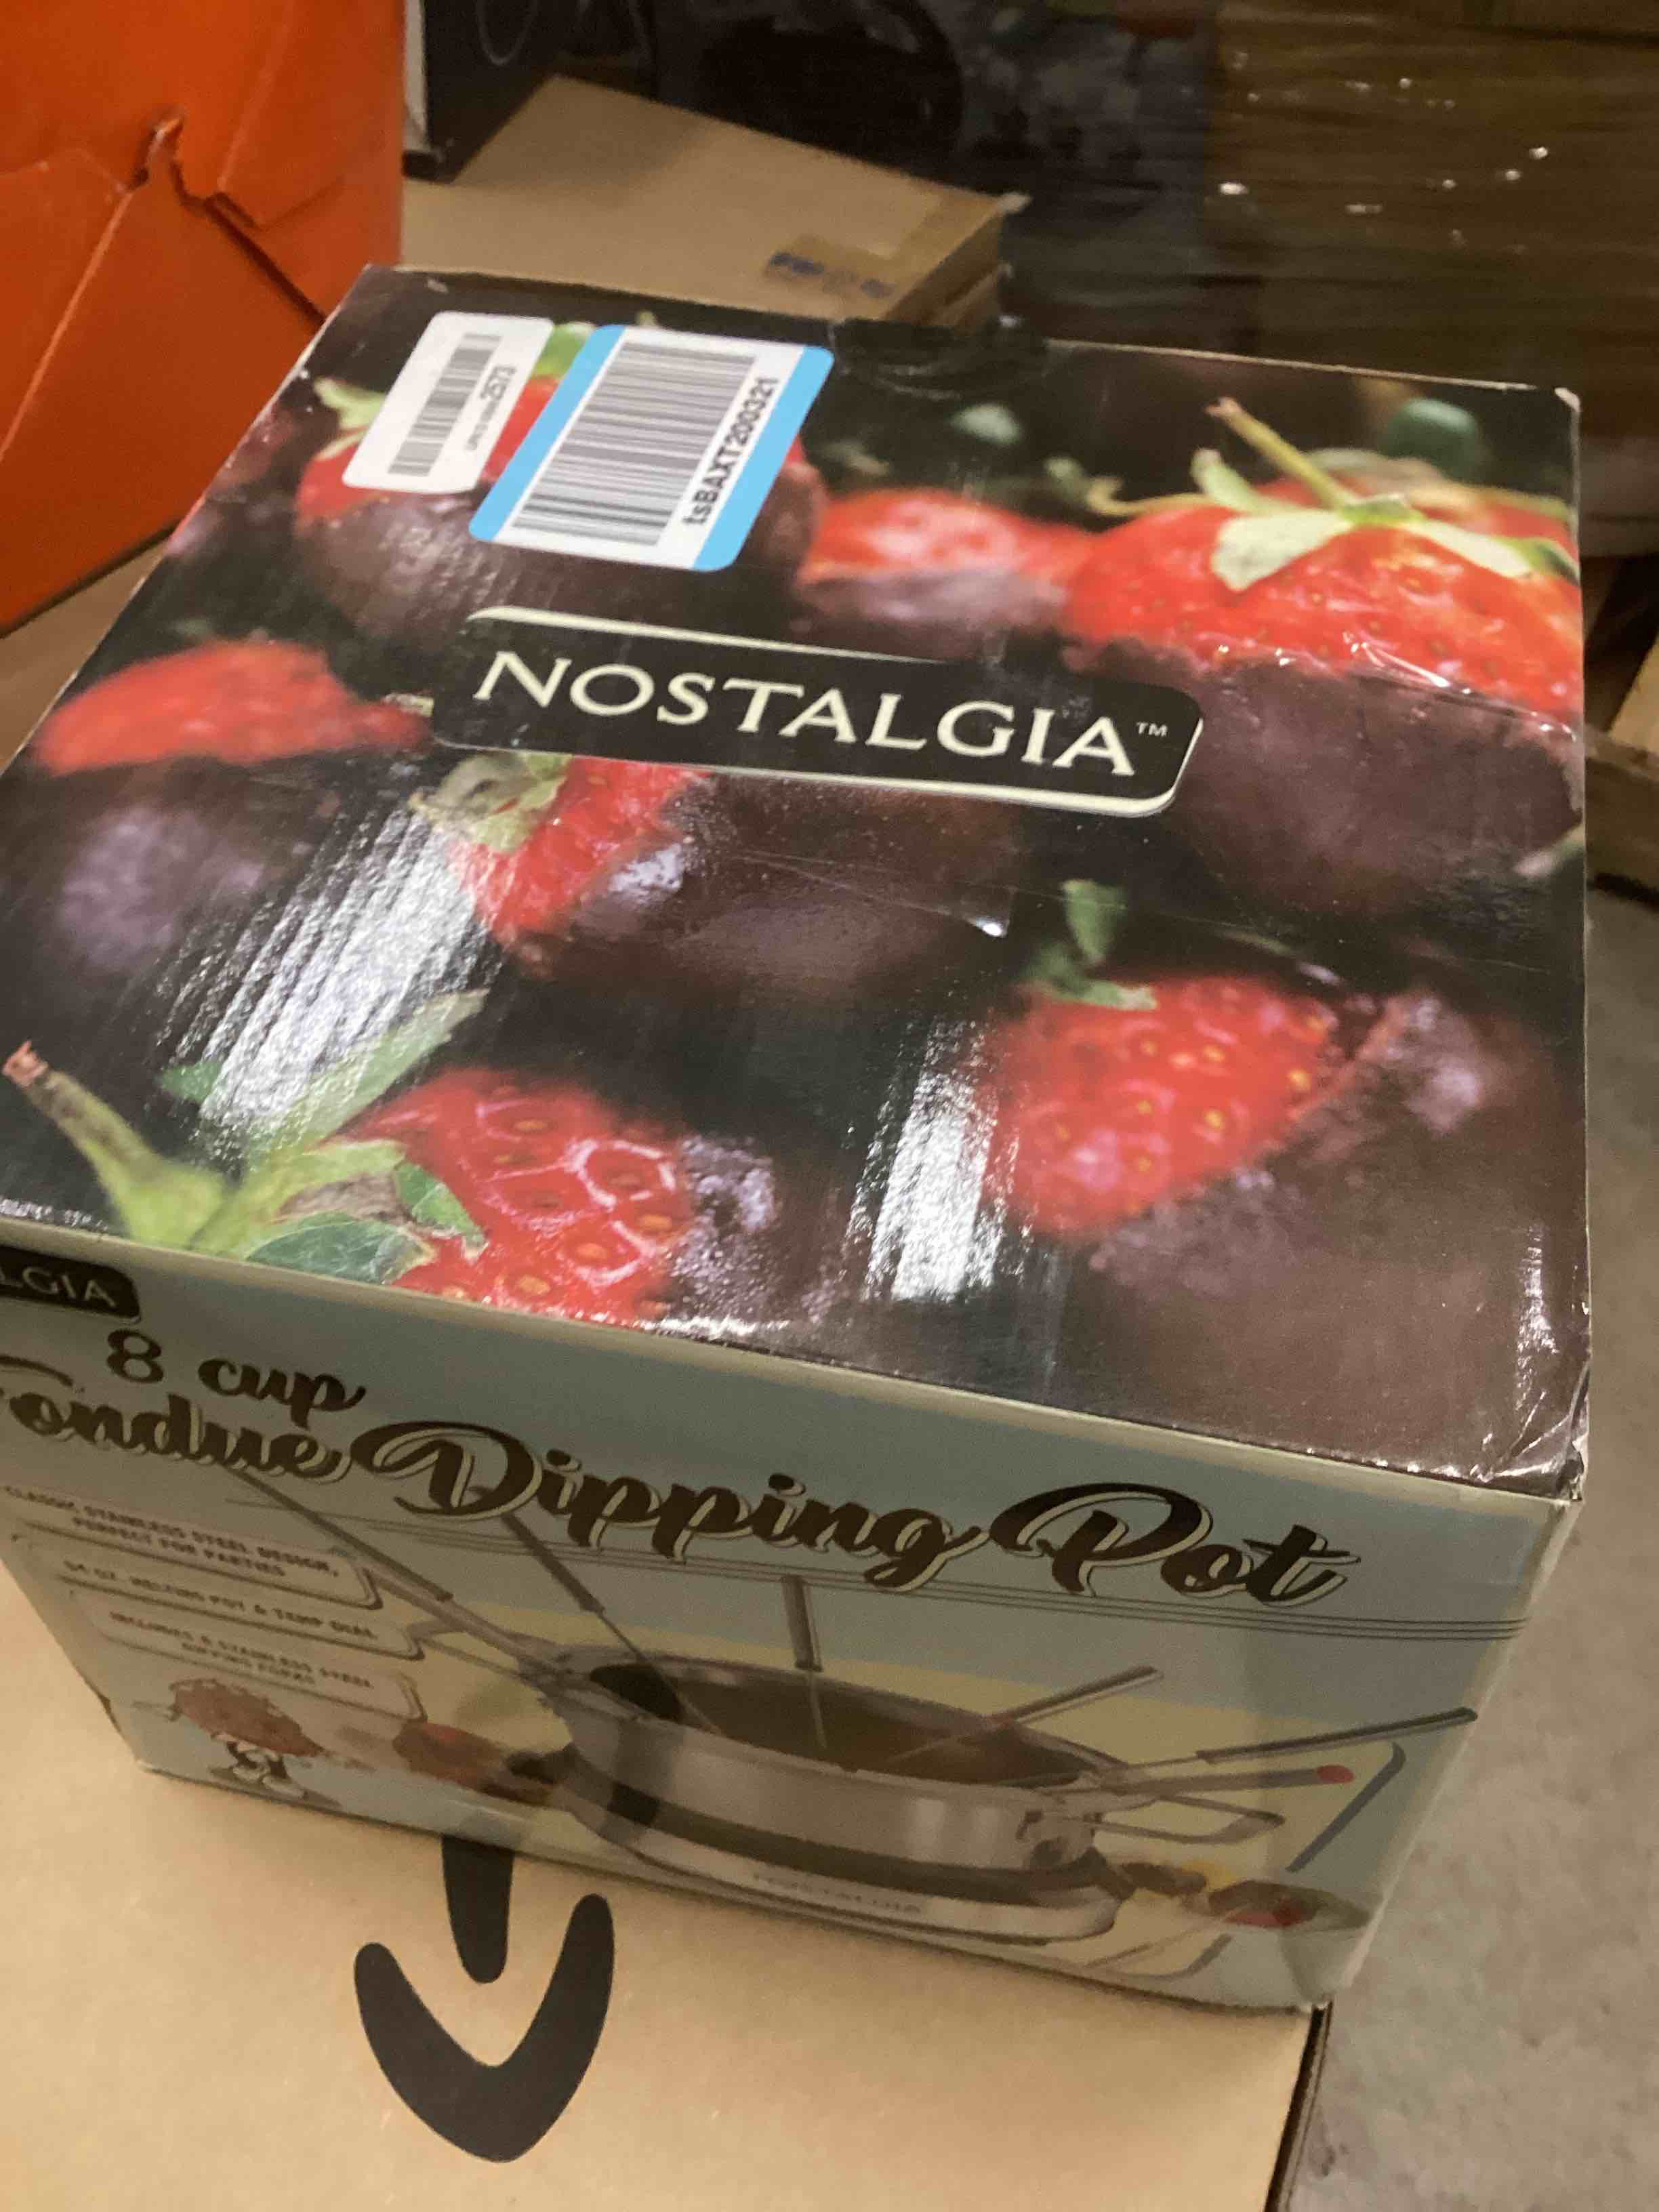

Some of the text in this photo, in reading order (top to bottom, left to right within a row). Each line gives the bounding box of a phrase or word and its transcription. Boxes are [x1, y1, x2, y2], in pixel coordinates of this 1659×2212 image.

[473, 650, 1135, 776] NOSTALGIA
[106, 1328, 367, 1430] 8 cup
[349, 1420, 987, 1591] Dipping
[989, 1482, 1361, 1607] Pot
